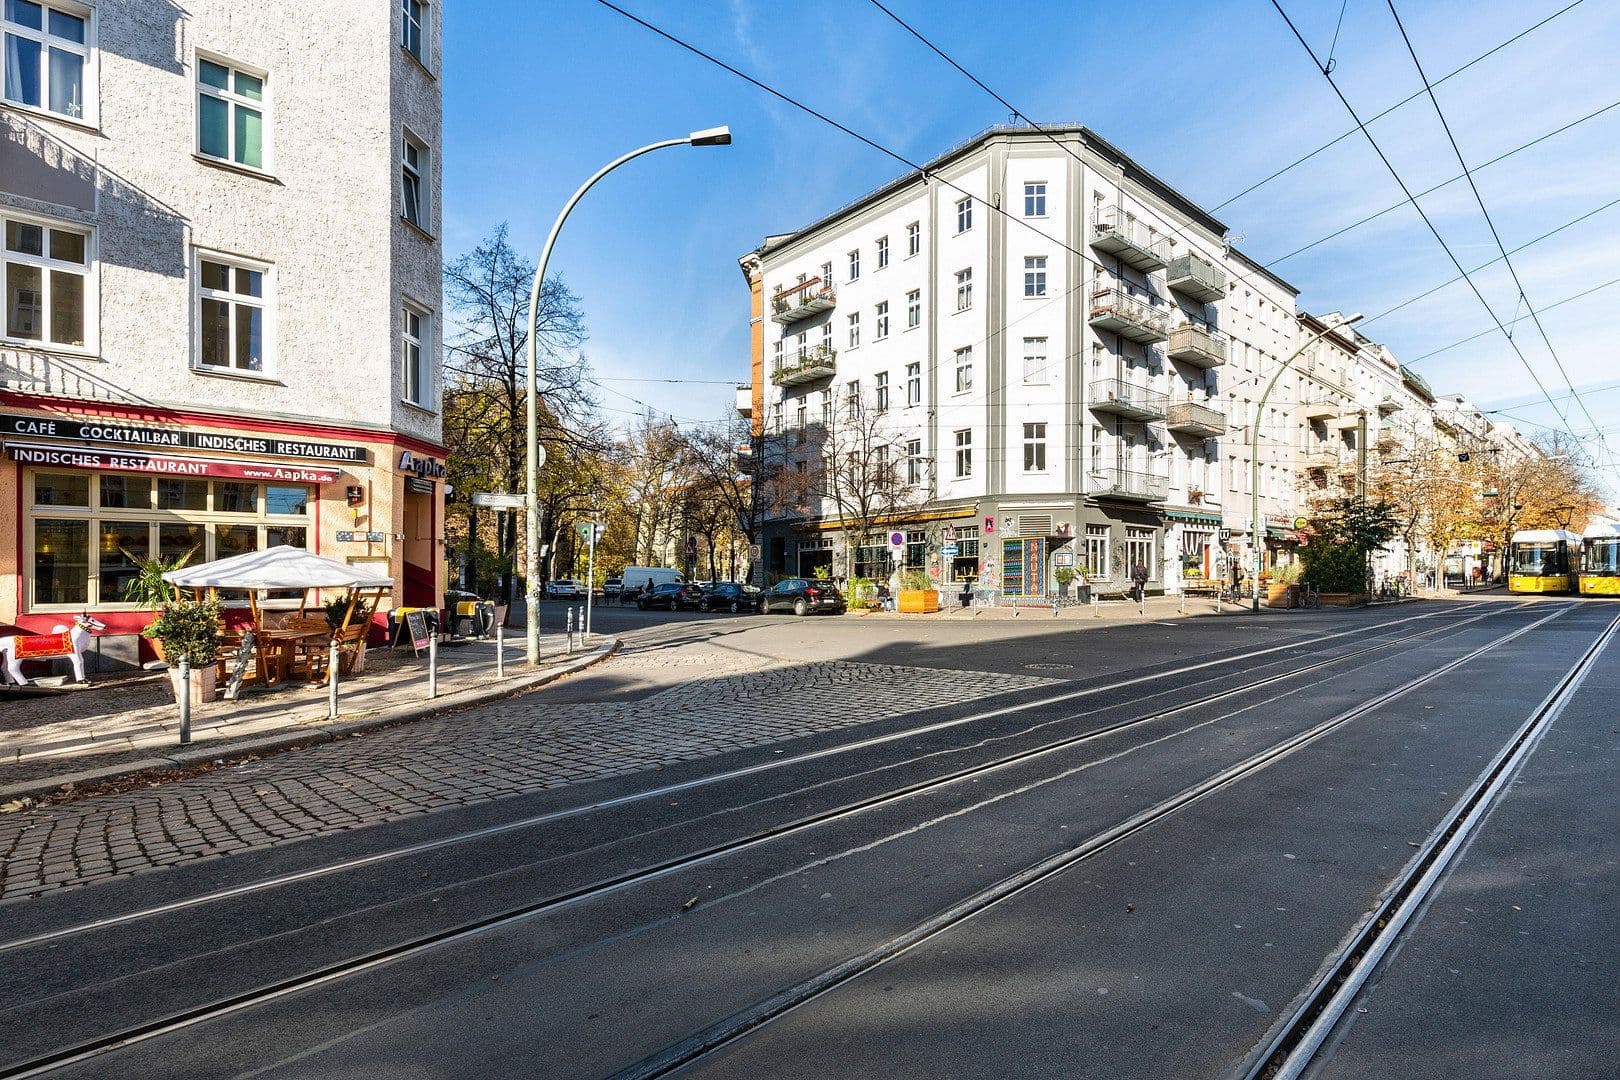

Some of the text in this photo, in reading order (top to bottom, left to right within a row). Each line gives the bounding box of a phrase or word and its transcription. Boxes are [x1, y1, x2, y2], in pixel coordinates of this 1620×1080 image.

[15, 420, 356, 459] CAFÉ COCKTAILBAR INDISCHES RESTAURANT
[14, 449, 100, 467] INDISCHES
[110, 457, 208, 474] RESTAURANT
[399, 450, 447, 478] Aapka
[1030, 542, 1038, 592] NAUTA
